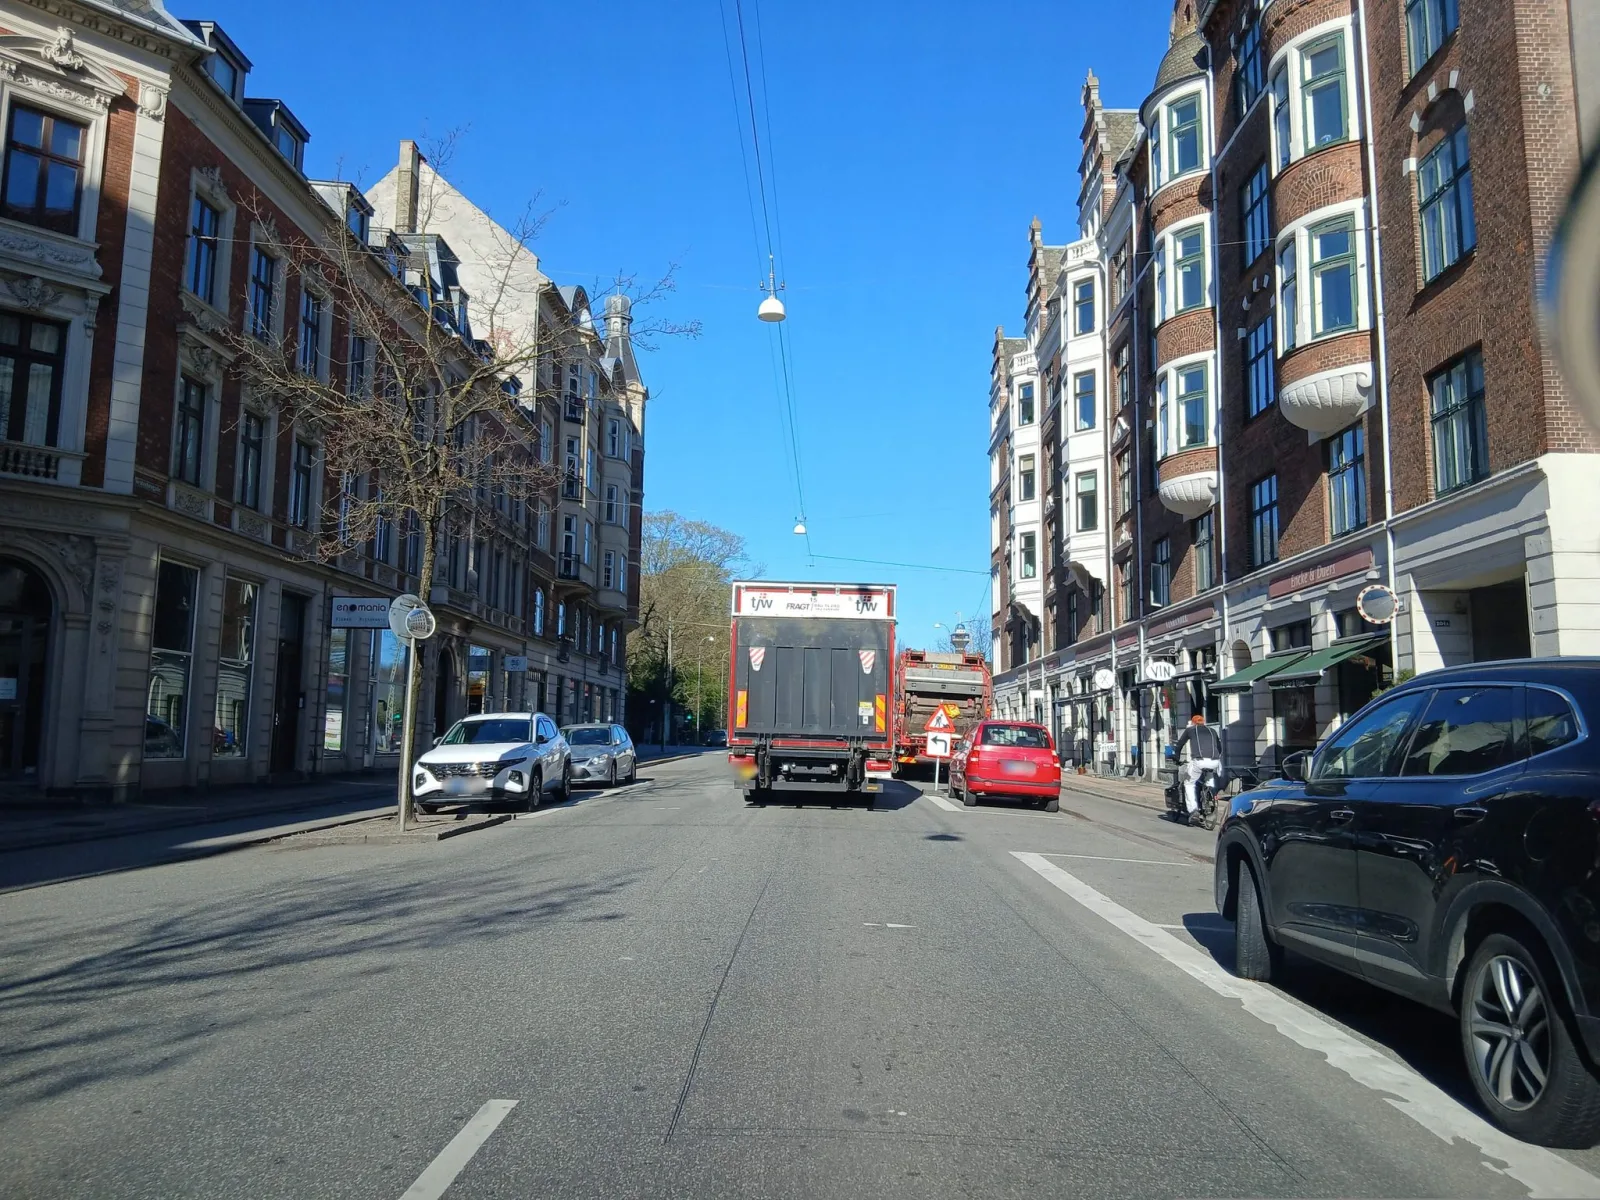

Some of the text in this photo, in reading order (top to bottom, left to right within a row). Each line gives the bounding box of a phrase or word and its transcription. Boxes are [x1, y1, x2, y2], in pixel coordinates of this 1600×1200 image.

[336, 603, 386, 612] enomania
[786, 602, 810, 610] FRAGT
[1150, 666, 1171, 679] VIN
